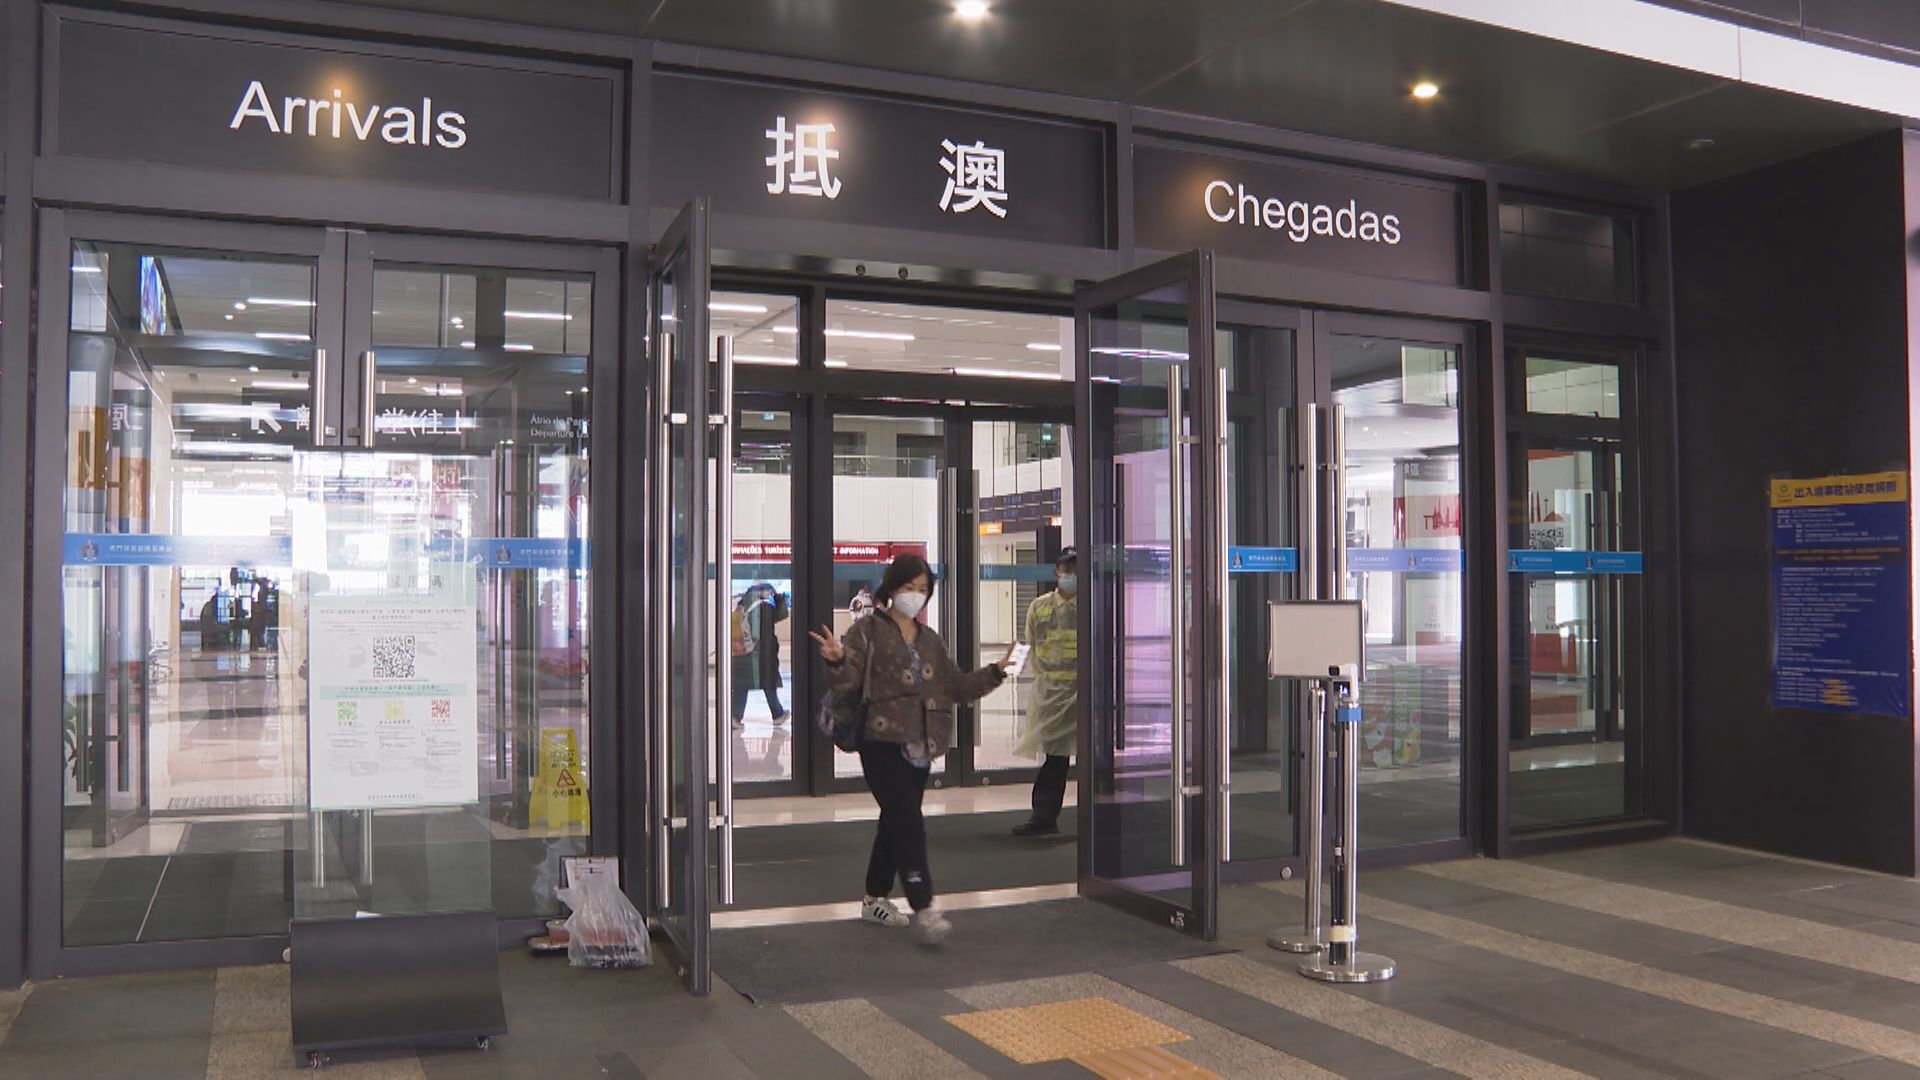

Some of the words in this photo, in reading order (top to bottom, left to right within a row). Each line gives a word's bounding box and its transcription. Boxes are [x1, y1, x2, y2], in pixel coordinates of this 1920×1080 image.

[229, 80, 467, 149] Arrivals
[765, 116, 1009, 219] 抵澳
[1203, 179, 1402, 245] Chegadas
[530, 428, 575, 439] Departure
[839, 546, 879, 556] INFORMATION
